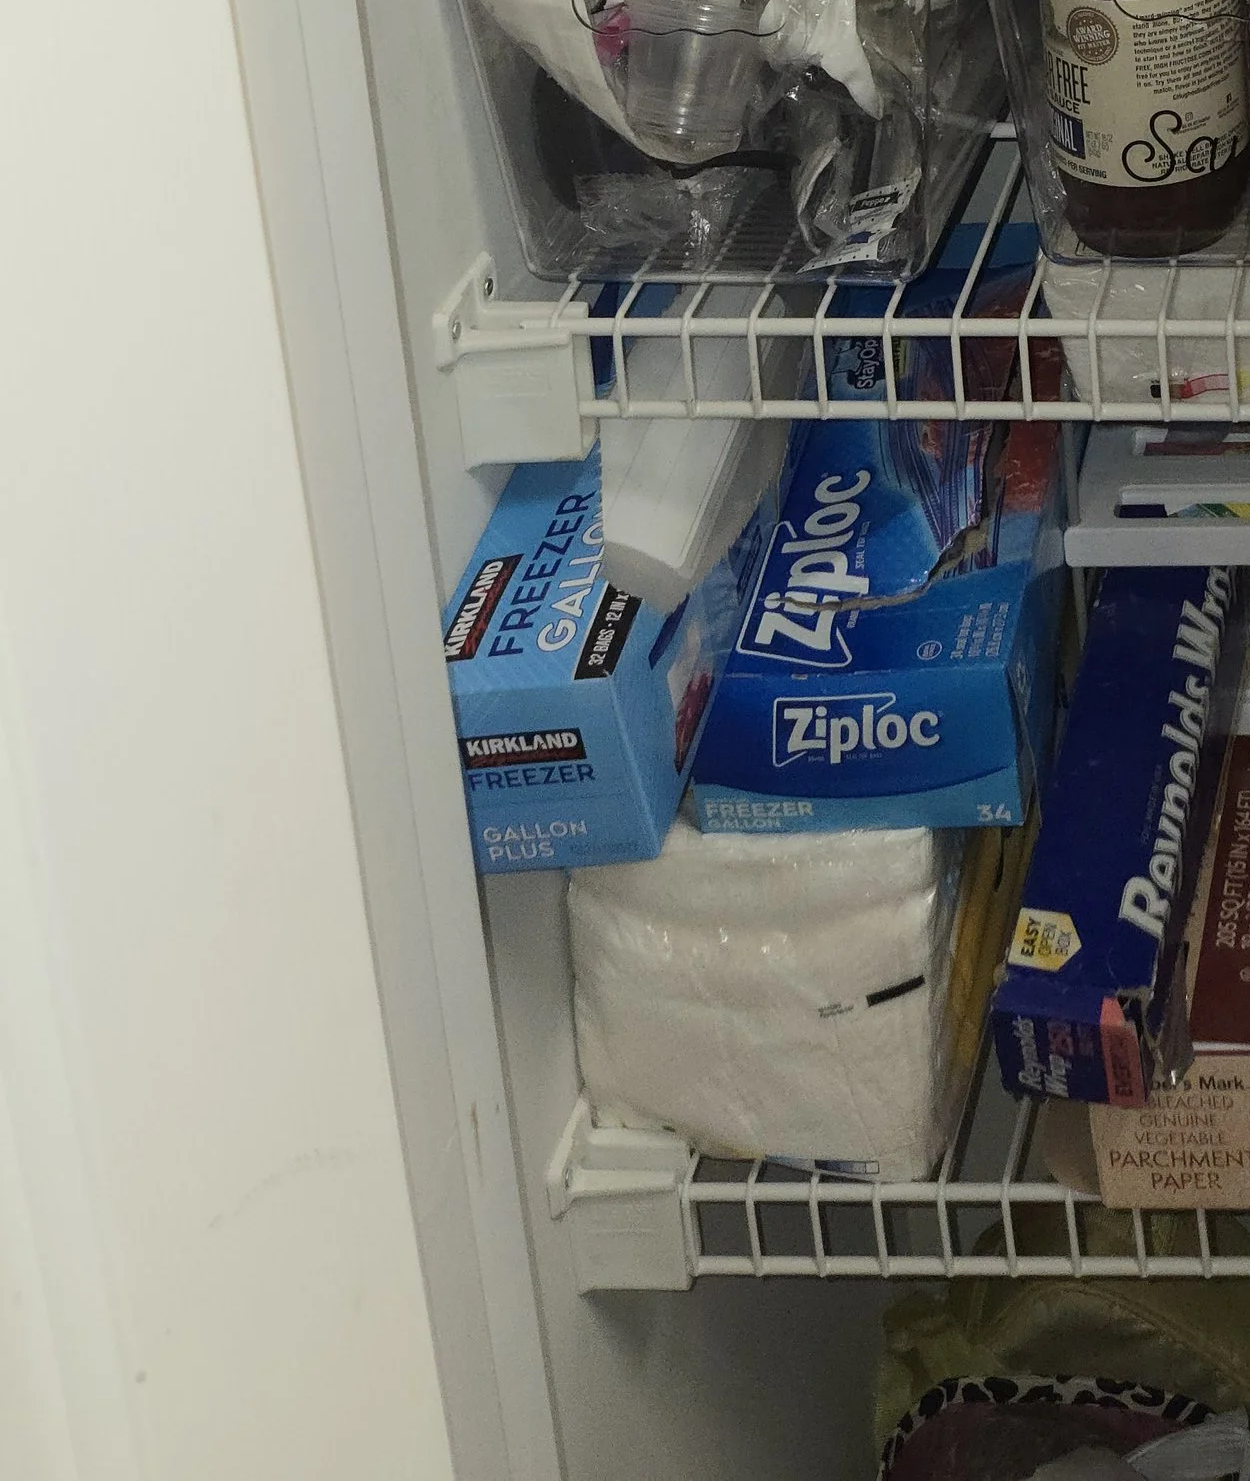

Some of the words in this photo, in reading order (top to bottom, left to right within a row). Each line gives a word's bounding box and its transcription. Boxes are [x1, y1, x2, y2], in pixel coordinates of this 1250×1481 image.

[1057, 62, 1091, 105] FREE
[487, 490, 597, 658] FREEZER
[754, 469, 872, 652] Ziploc
[444, 560, 503, 657] KIRKLAND
[466, 732, 578, 758] KIRKLAND
[783, 704, 940, 765] Ziploc
[468, 764, 595, 792] FREEZER
[704, 800, 813, 818] FREEZER
[976, 804, 1011, 822] 34
[483, 820, 587, 843] GALLON
[488, 841, 555, 862] PLUS
[1021, 916, 1038, 958] EASY
[1151, 1172, 1222, 1190] PAPER
